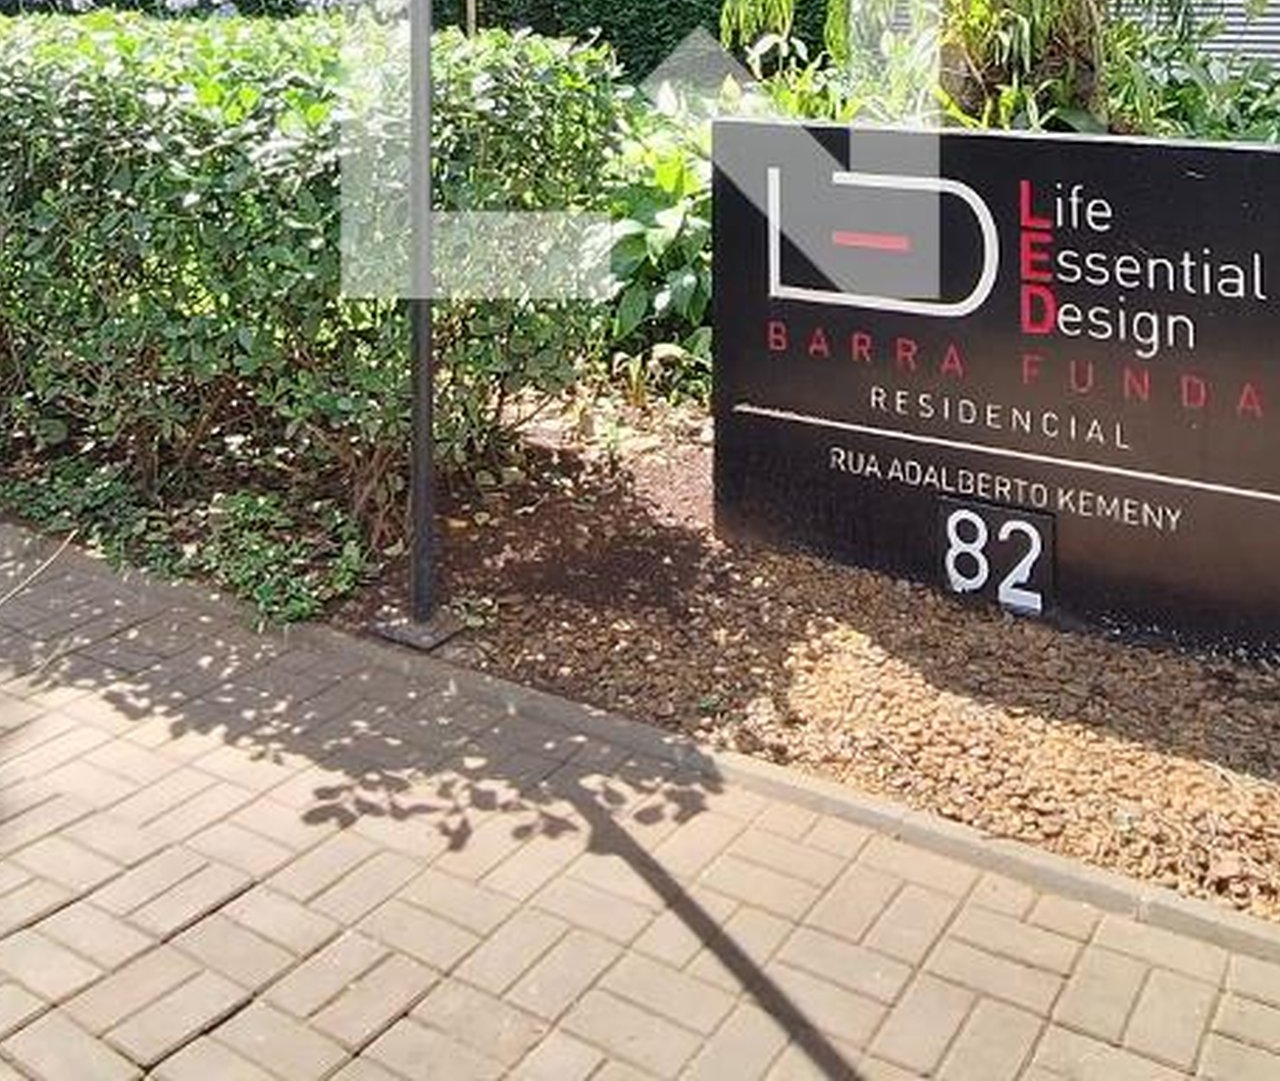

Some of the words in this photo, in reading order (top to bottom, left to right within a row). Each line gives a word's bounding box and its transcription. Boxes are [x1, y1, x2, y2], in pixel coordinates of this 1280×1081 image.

[1019, 179, 1113, 232] Life
[1020, 231, 1268, 301] Essential
[1020, 284, 1196, 359] Design
[769, 321, 964, 377] BARRA
[1022, 353, 1263, 418] FUNDA
[870, 386, 1132, 450] RESIDENCIAL
[829, 447, 882, 480] RUA
[887, 458, 1049, 508] ADALBERTO
[1057, 489, 1183, 532] KEMENY
[945, 508, 1043, 615] 82
